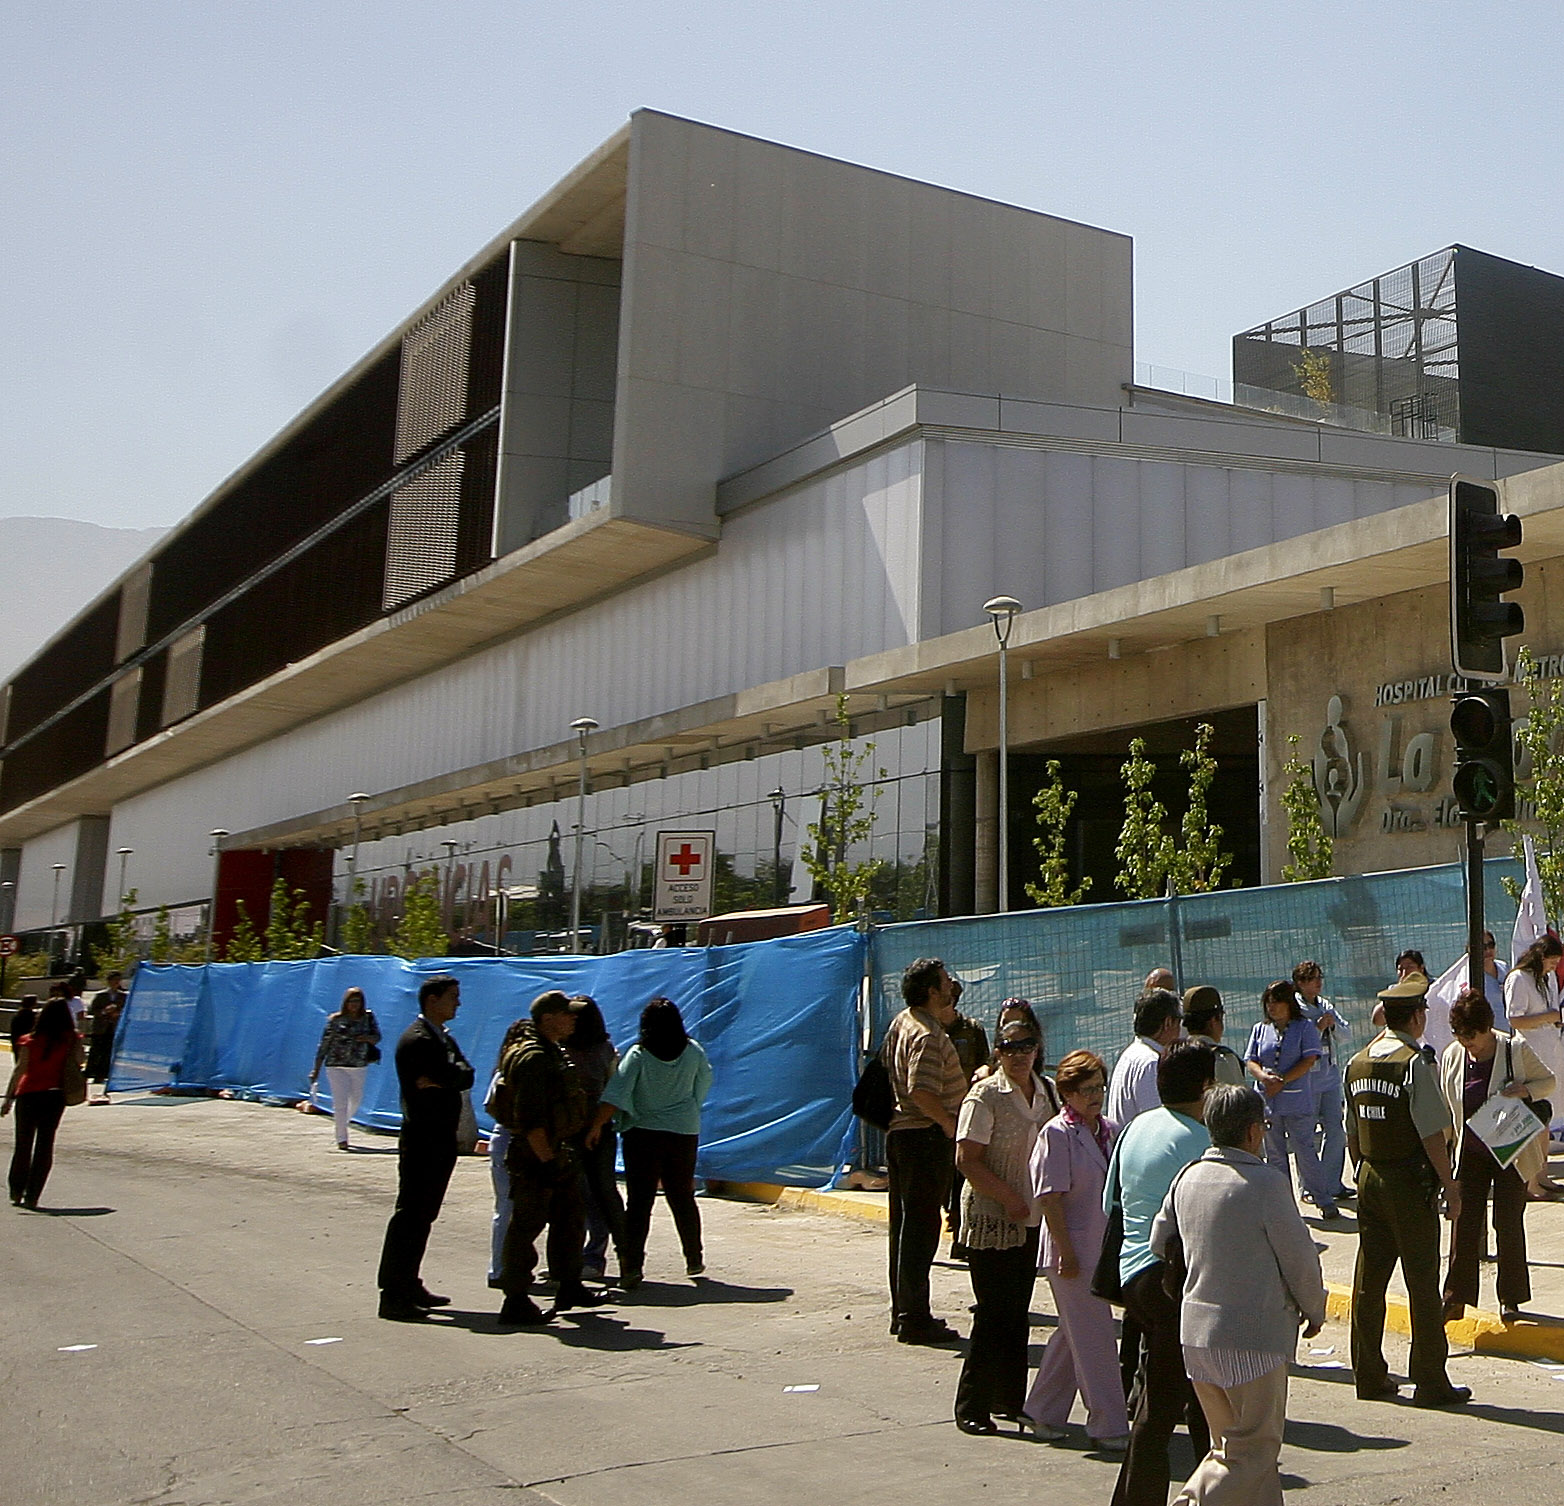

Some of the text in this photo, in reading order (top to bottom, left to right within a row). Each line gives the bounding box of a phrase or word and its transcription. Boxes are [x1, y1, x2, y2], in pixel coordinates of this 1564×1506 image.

[1374, 674, 1443, 708] HOSPITAL
[1377, 713, 1442, 793] La
[669, 883, 700, 893] ACCESO
